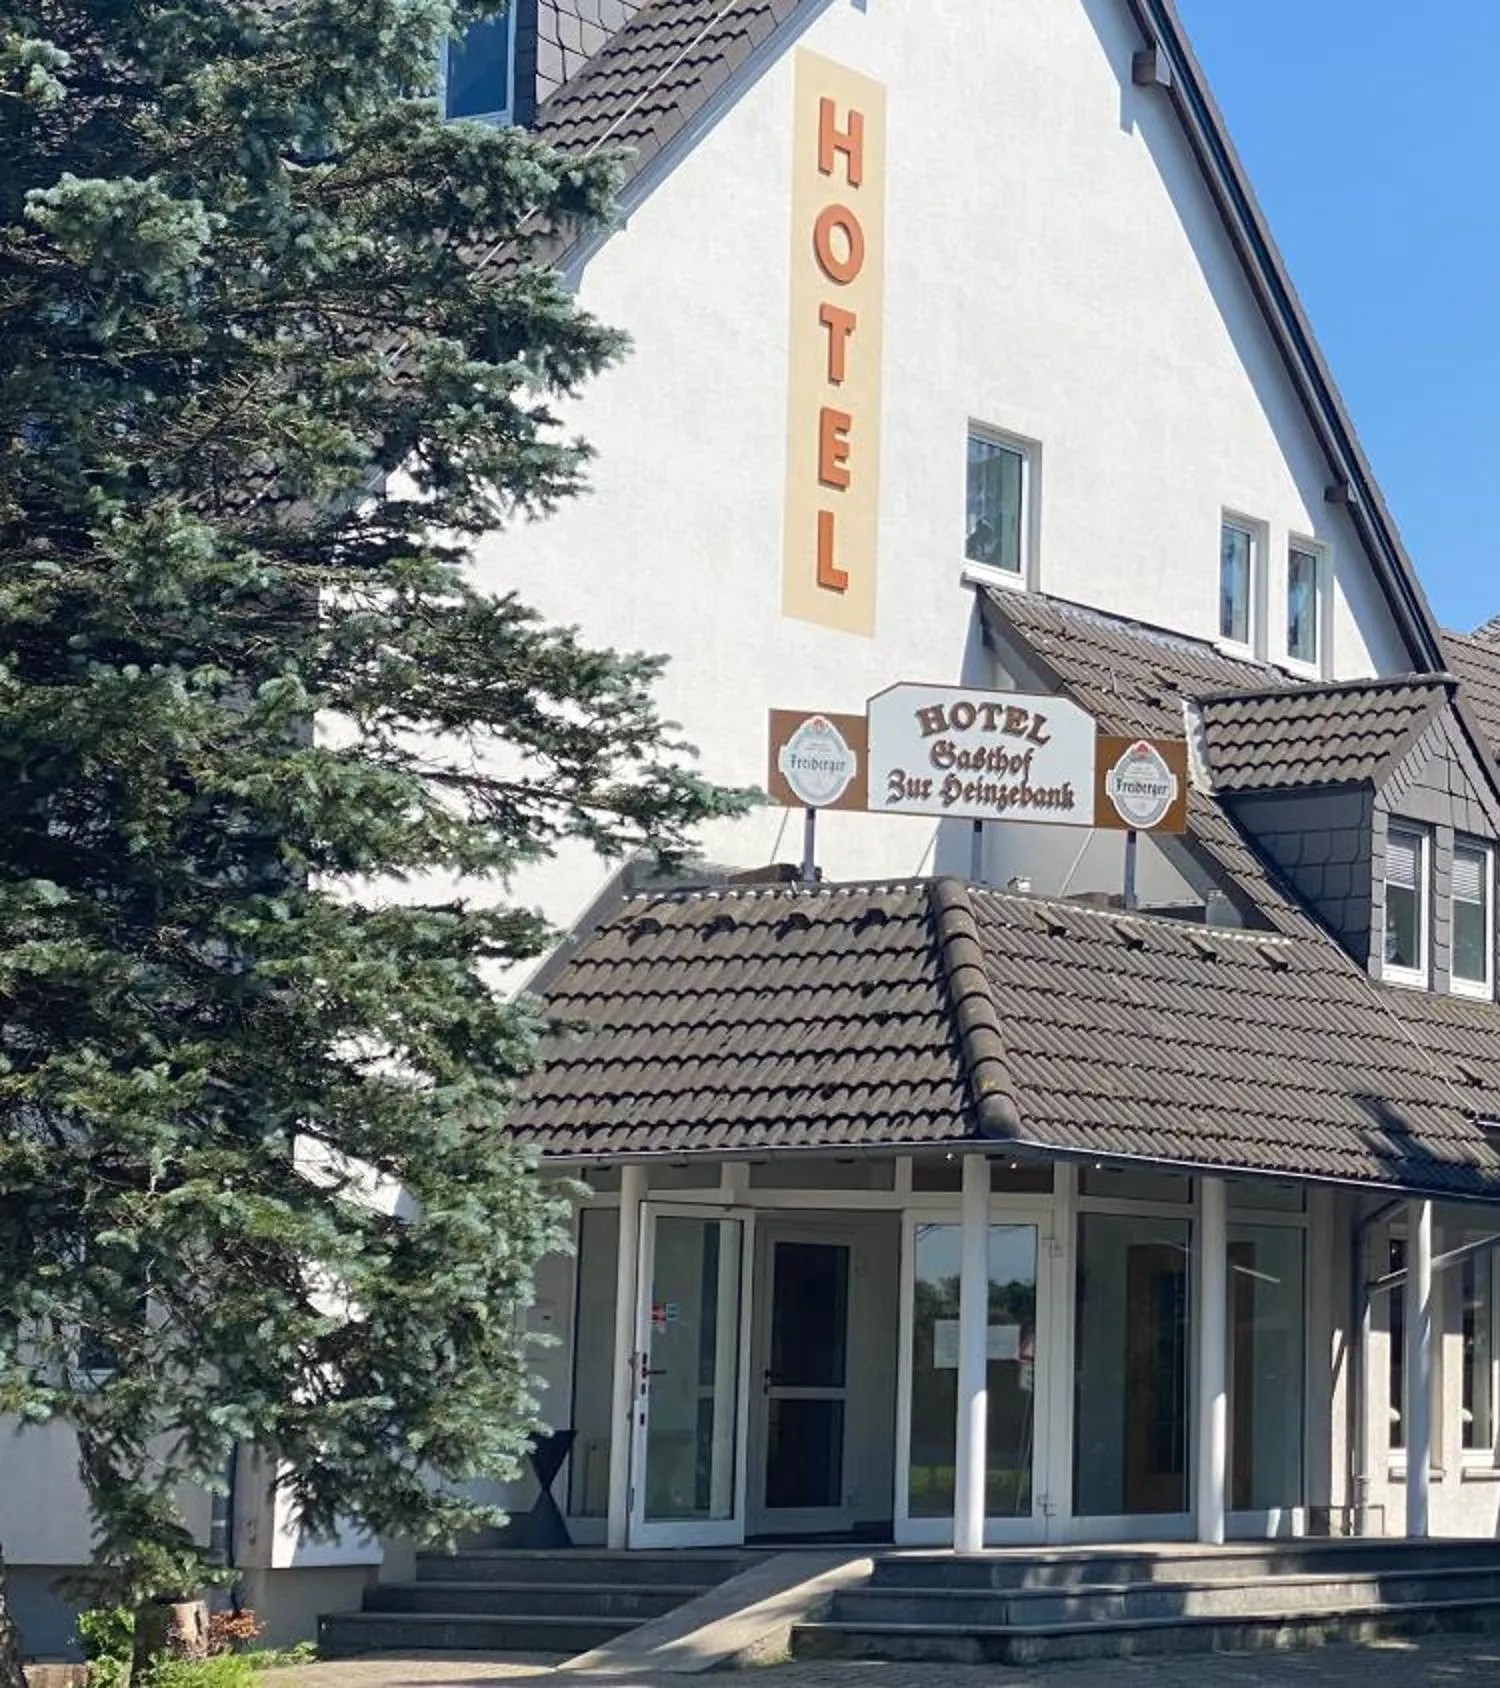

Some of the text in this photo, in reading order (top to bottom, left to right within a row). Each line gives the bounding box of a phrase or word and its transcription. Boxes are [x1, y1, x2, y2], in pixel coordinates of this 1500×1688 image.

[814, 97, 865, 593] HOTEL
[915, 701, 1051, 747] HOTEL
[930, 740, 1035, 783] Gasthof
[885, 768, 1075, 812] Zur Heinzebank
